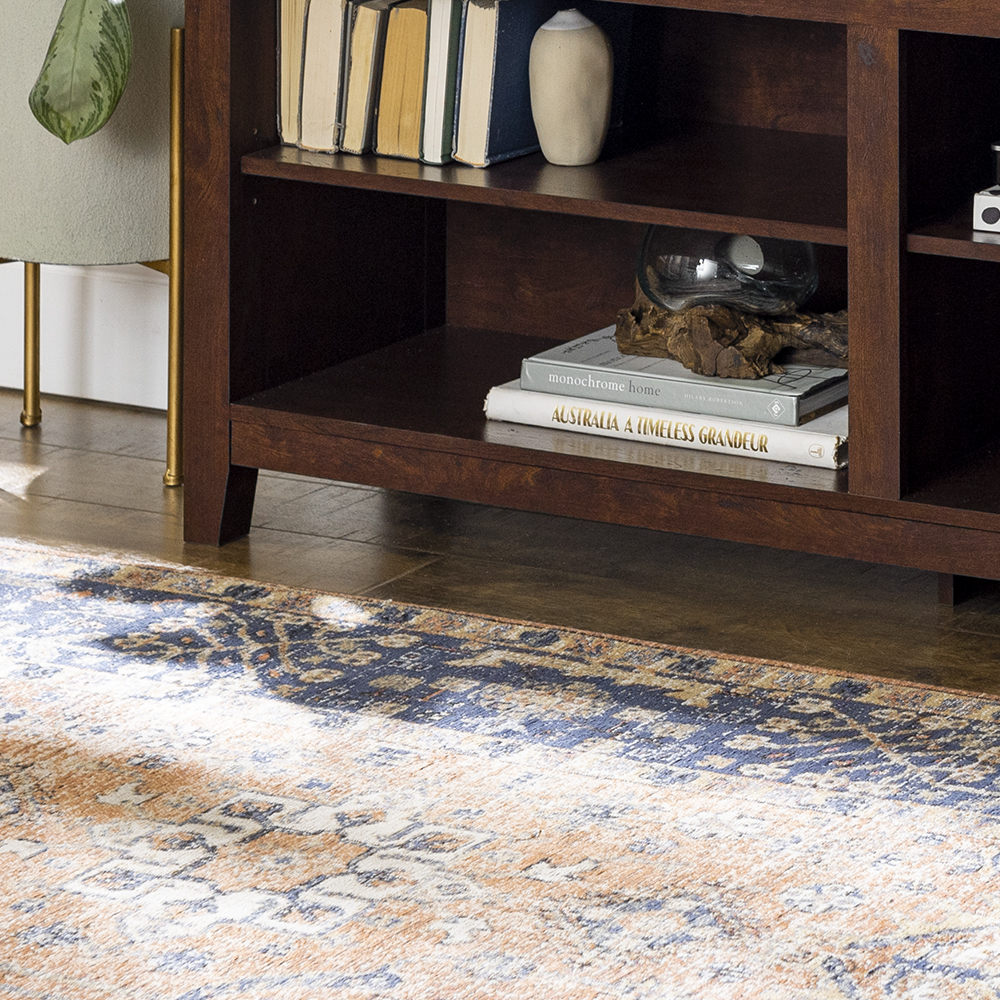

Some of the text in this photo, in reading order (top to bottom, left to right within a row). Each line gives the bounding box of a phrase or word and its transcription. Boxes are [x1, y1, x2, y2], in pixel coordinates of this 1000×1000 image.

[548, 373, 661, 397] monochrome home
[551, 404, 768, 453] AUSTRALIA A TIMELESS GRANDEUR
